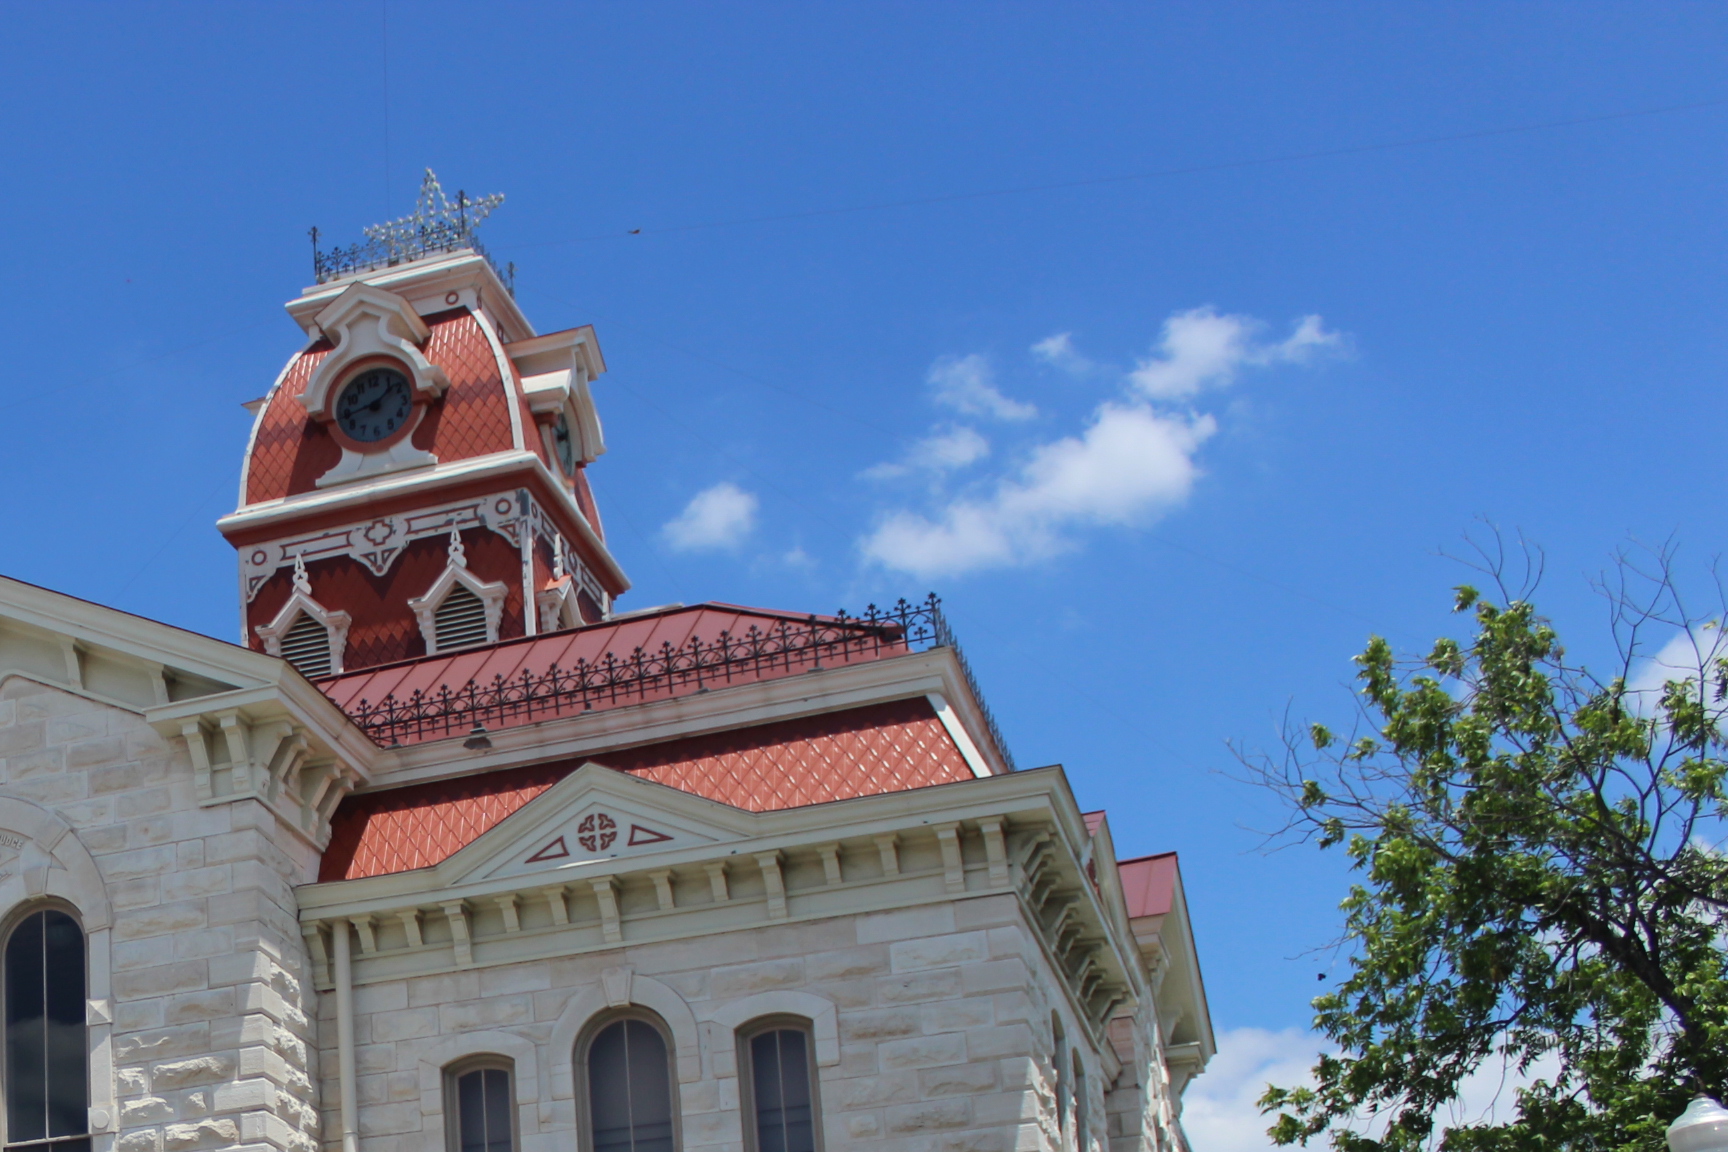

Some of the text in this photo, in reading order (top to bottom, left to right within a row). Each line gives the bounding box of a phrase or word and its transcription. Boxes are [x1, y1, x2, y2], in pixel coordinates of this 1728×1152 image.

[368, 375, 379, 388] 12
[357, 383, 365, 394] 11
[347, 393, 358, 406] 10
[401, 394, 408, 406] 3
[396, 407, 403, 418] 4
[349, 419, 356, 431] 8
[360, 424, 367, 436] 7
[387, 418, 394, 430] 5
[373, 425, 381, 437] 6
